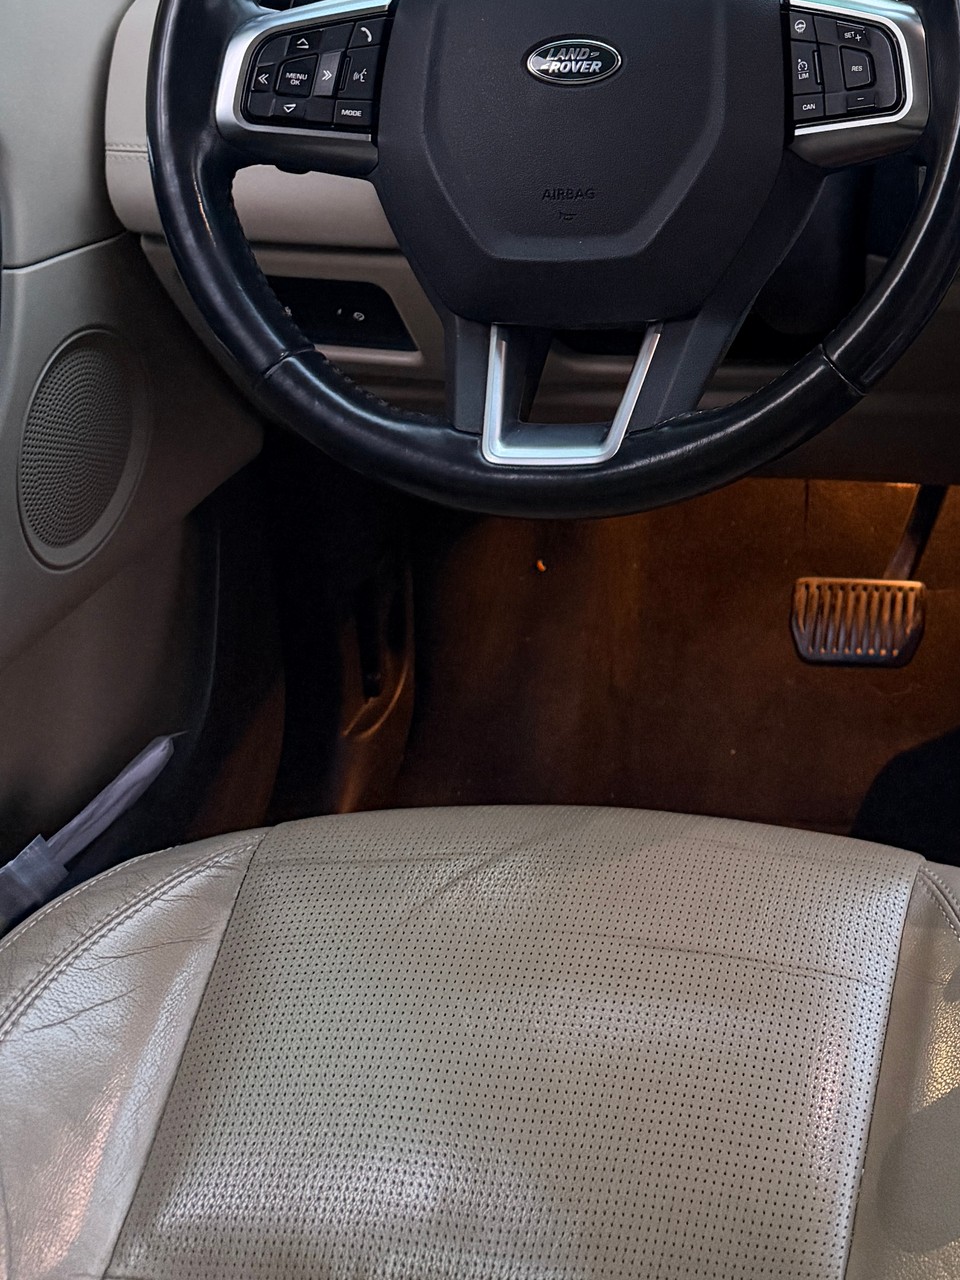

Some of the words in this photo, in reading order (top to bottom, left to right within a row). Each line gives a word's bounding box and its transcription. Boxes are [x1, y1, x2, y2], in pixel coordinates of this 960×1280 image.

[546, 47, 590, 61] LAND
[548, 60, 602, 73] ROVER
[285, 71, 308, 80] MENU
[341, 108, 362, 117] MODE
[802, 103, 816, 111] CAN
[541, 187, 596, 201] AIRBAG
